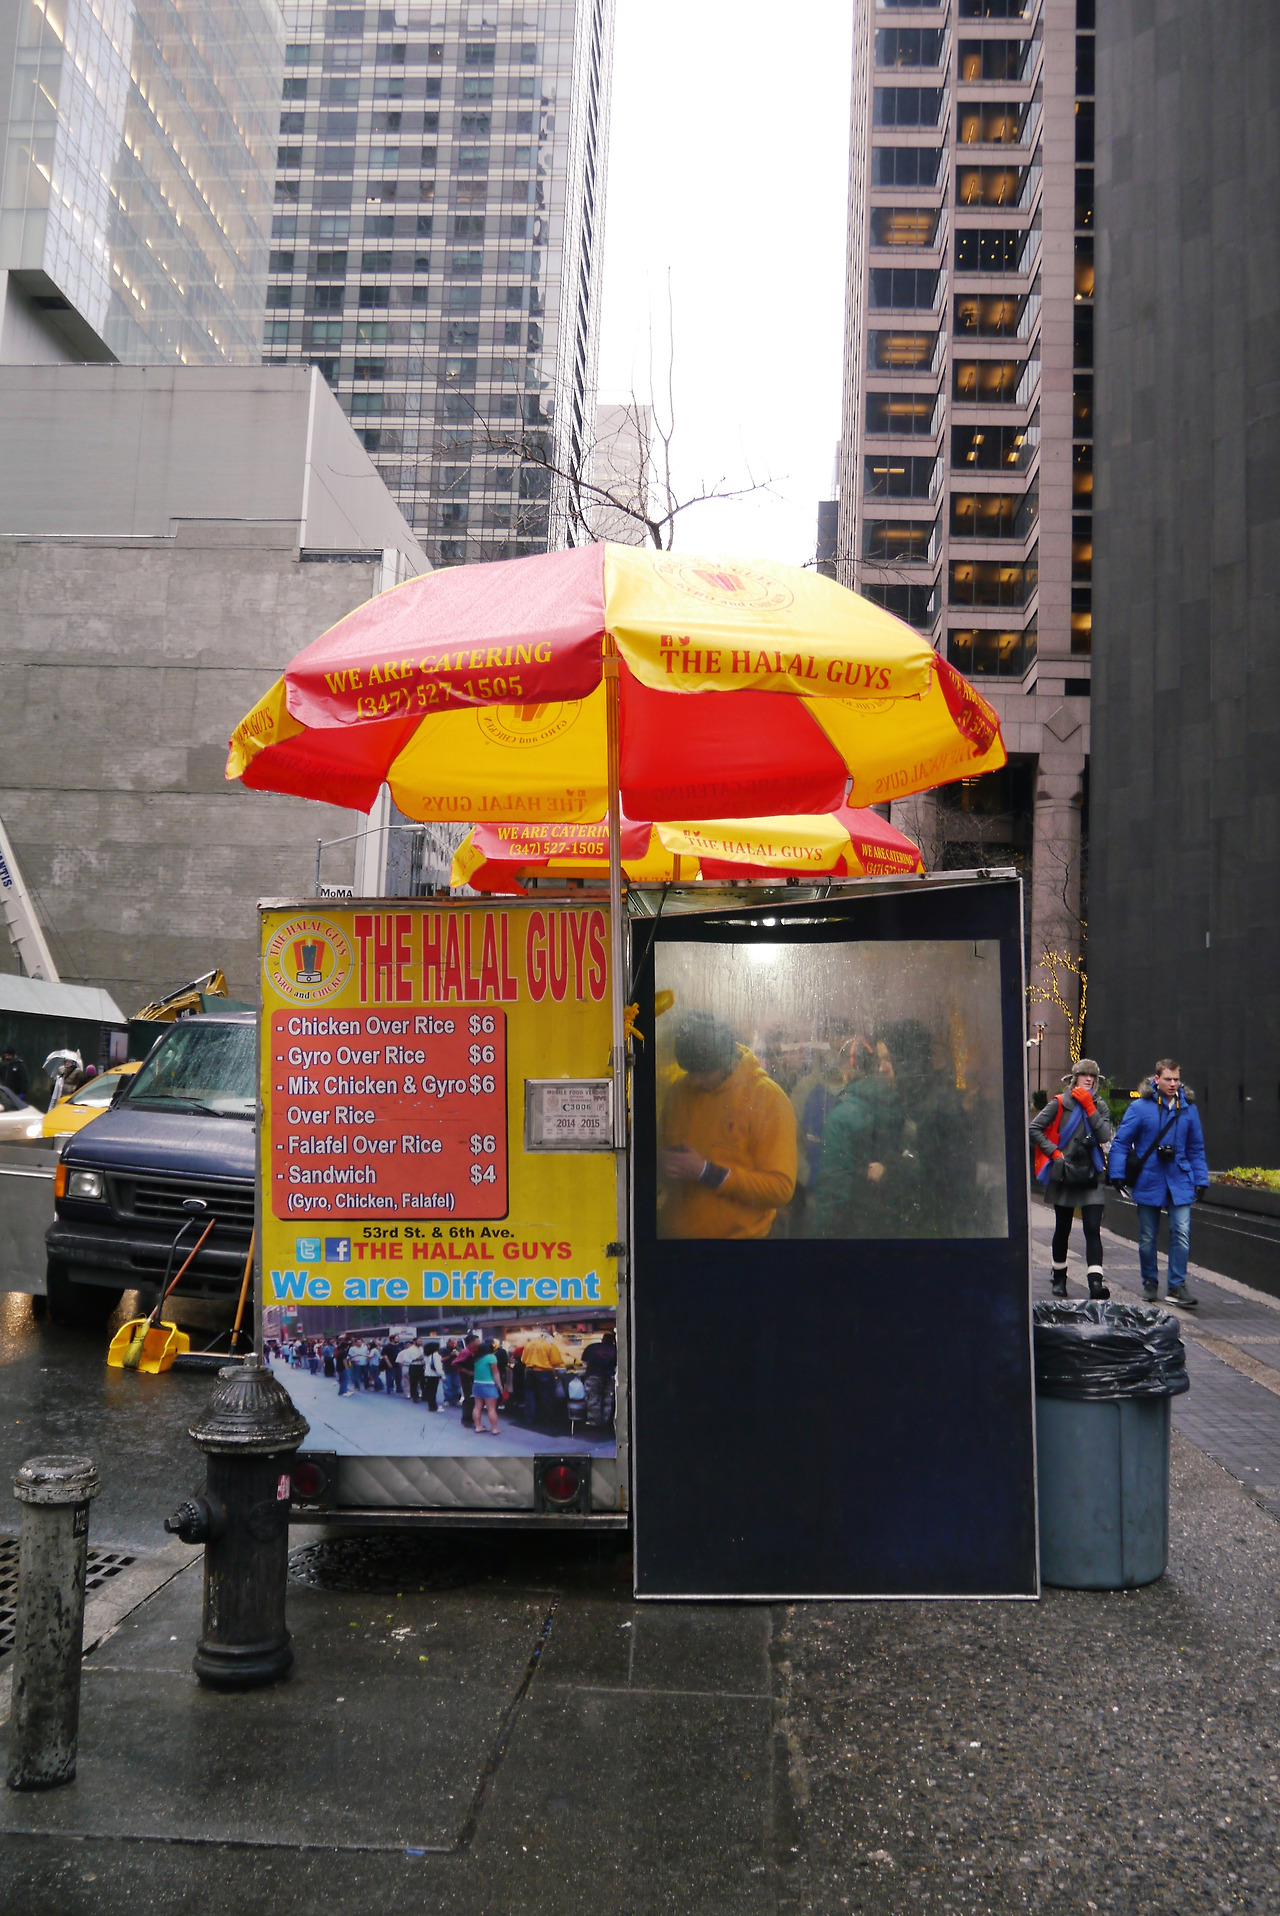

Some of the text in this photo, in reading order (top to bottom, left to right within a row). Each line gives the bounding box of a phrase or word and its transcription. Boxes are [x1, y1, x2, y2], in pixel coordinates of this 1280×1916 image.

[323, 641, 552, 695] WE ARE CATERING
[660, 650, 892, 690] THE HALAL GUYS
[357, 676, 523, 719] (347) 527-1505
[497, 824, 622, 840] WE ARE CATERIN
[509, 842, 604, 856] (347) 527-1505
[685, 836, 823, 861] THE HALAL GUYS
[861, 843, 873, 858] WE
[873, 846, 885, 860] ARE
[320, 888, 353, 898] MoMA
[268, 920, 348, 957] THE HALAL GUYS
[354, 909, 607, 1003] THE HALAL GUYS
[273, 969, 346, 999] GYRO and CHICKEN
[287, 1014, 495, 1036] Chicken Over Rice $6
[288, 1043, 495, 1070] Gyro Over Rice $6
[288, 1073, 495, 1098] Mix Chicken & Gyro $6
[287, 1106, 376, 1125] Over Rice
[556, 1119, 600, 1128] 2014 2015
[288, 1133, 496, 1156] Falafel Over Rice $6
[288, 1163, 497, 1186] Sandwich $4
[287, 1193, 455, 1212] (Gyro, Chicken, Falafel)
[363, 1226, 515, 1238] 53rd St. & 6th Ave.
[353, 1242, 403, 1260] THE
[412, 1242, 495, 1260] HALAL
[502, 1241, 572, 1261] GUYS
[270, 1269, 601, 1301] We are Different
